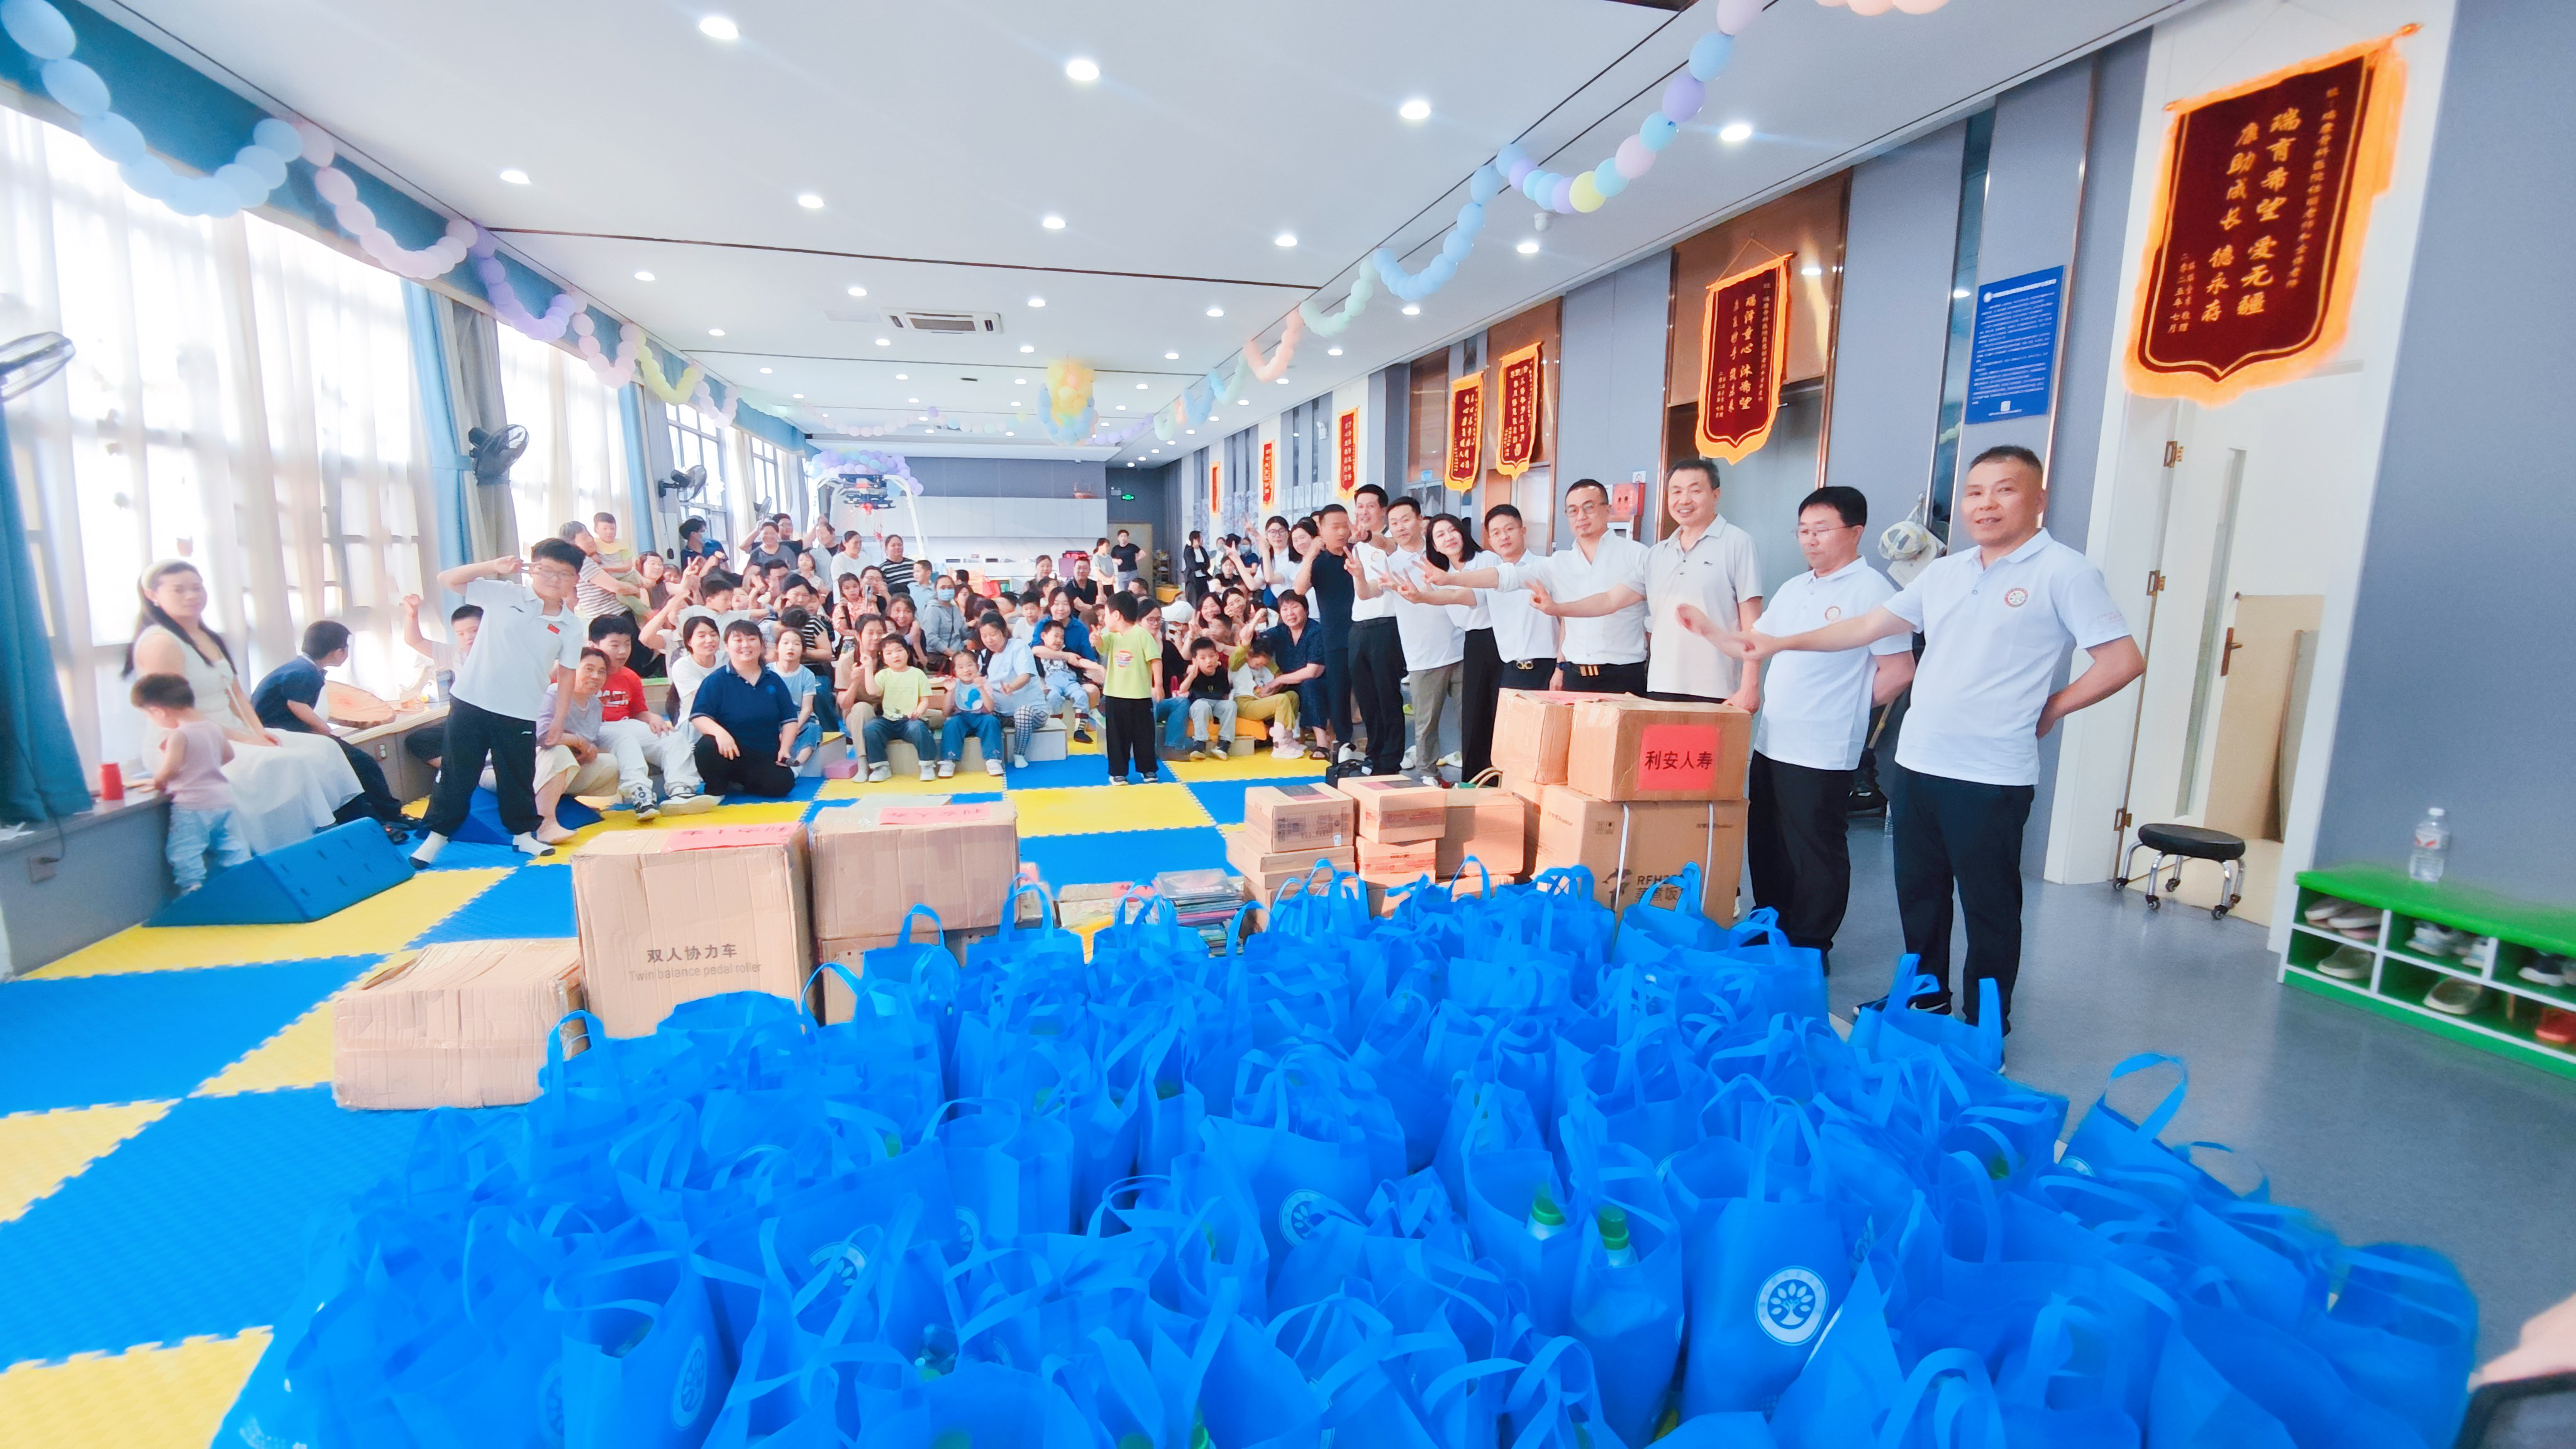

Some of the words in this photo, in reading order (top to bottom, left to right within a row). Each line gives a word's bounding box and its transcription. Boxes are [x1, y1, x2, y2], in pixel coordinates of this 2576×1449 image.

[2256, 108, 2302, 221] 瑞育希望
[2201, 244, 2235, 322] 德永存
[1644, 750, 1713, 770] 利安人寿
[647, 943, 738, 963] 双人协力车
[629, 970, 654, 982] Twin
[657, 967, 701, 979] balance
[703, 963, 733, 977] pedal
[735, 962, 762, 974] roller
